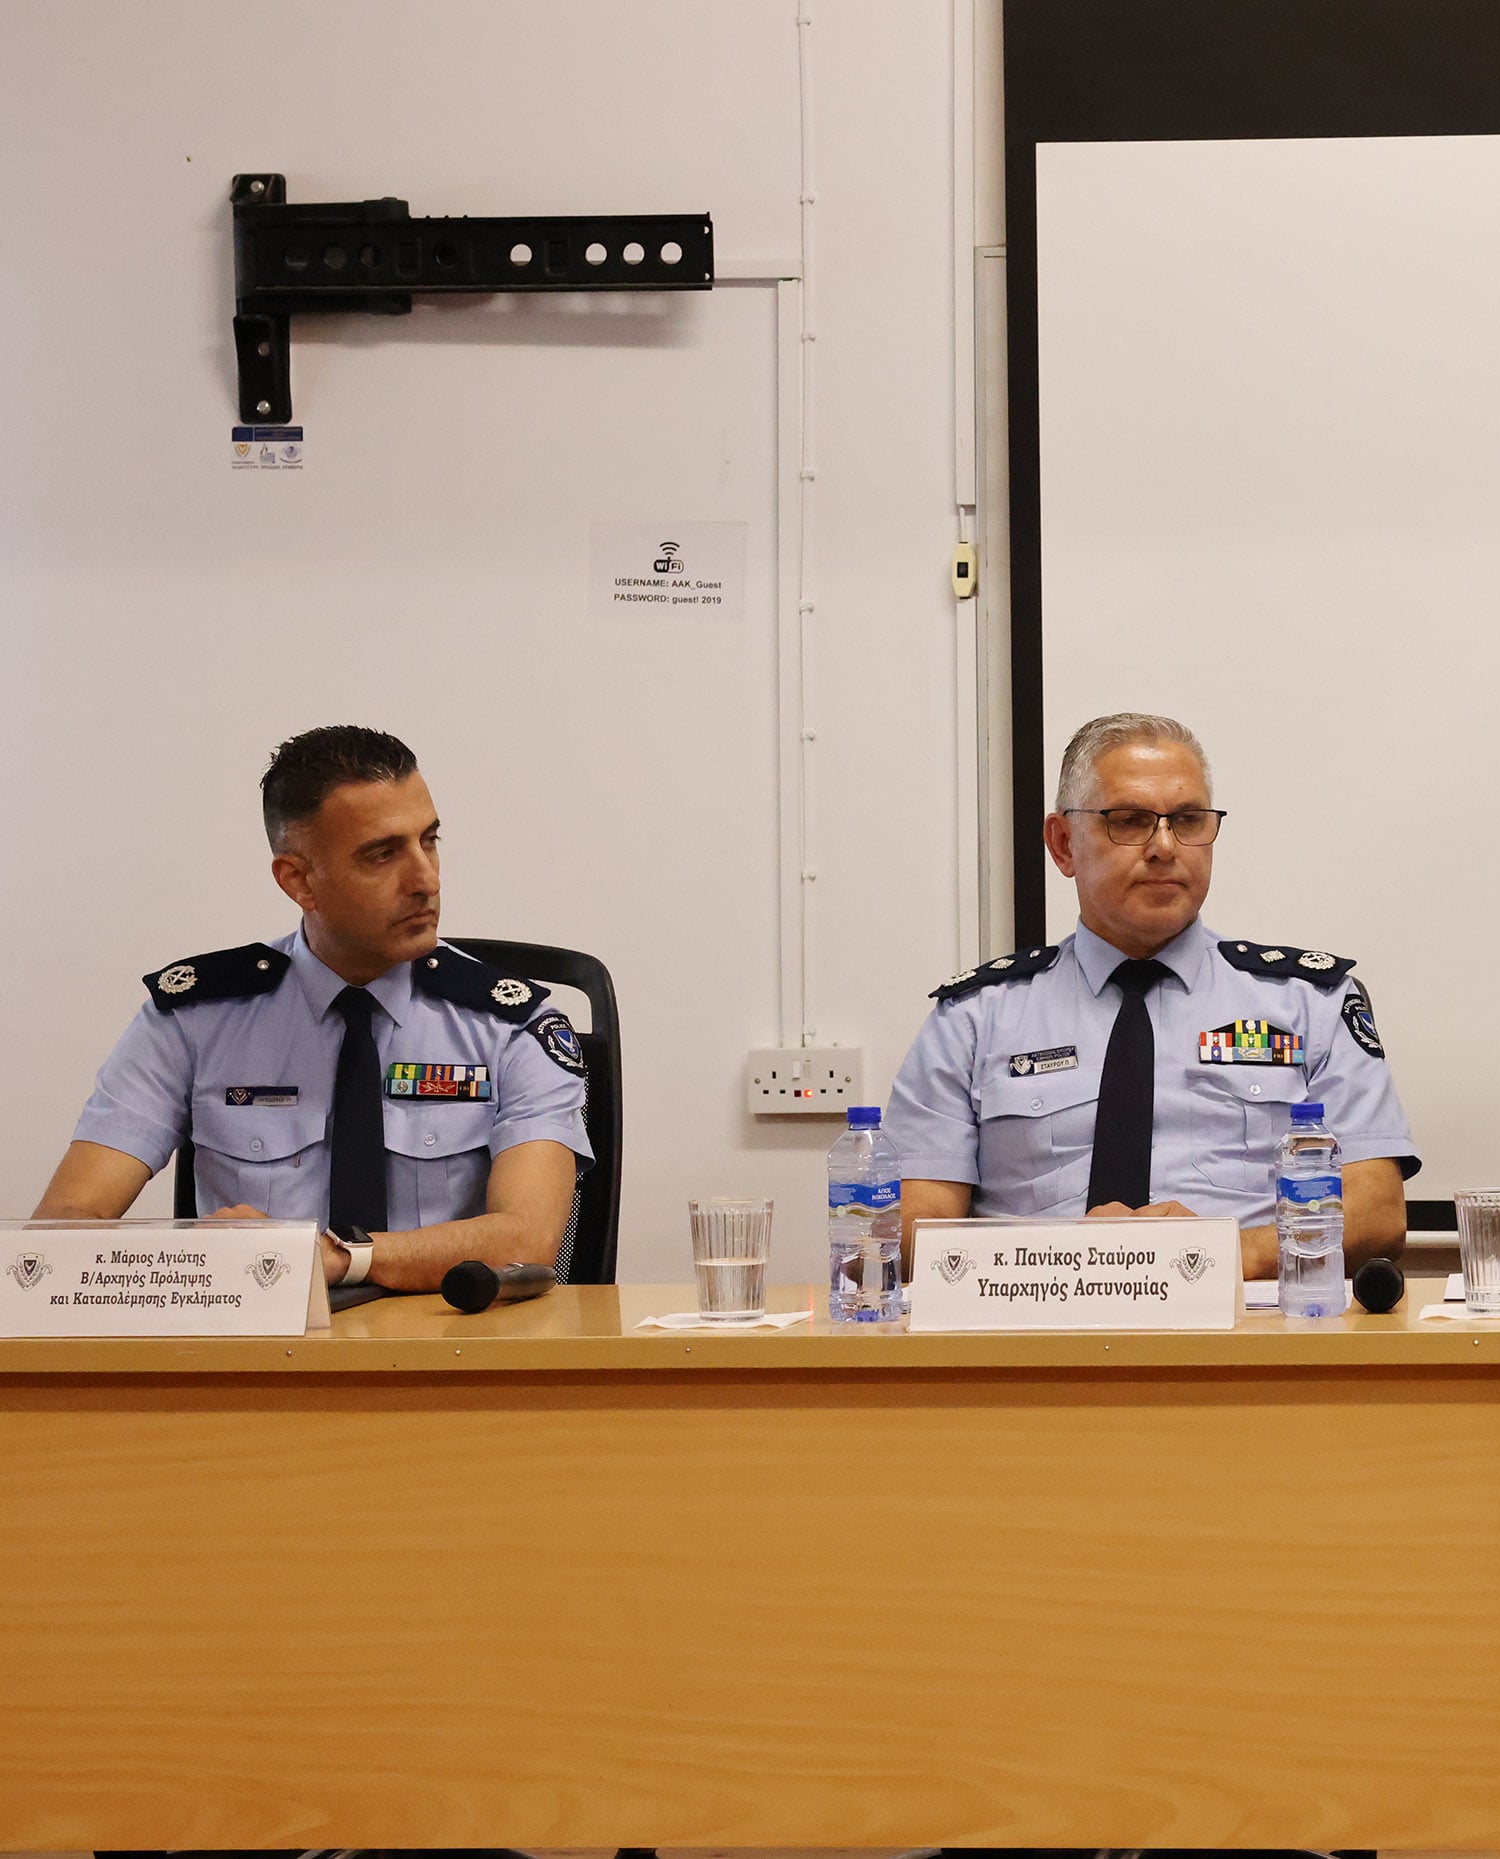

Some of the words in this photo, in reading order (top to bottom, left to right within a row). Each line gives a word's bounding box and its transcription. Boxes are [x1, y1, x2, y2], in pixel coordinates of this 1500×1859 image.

[615, 578, 669, 587] USERNAME:
[671, 580, 722, 590] AAK_Guest
[614, 593, 669, 603] PASSWORD:
[701, 596, 722, 604] 2019
[1040, 1060, 1064, 1070] ΣΤΑΥΡΟΥ
[95, 1253, 107, 1264] κ.
[111, 1250, 154, 1267] Μάριος
[157, 1250, 206, 1267] Αγιώτης
[995, 1253, 1008, 1266] κ.
[1014, 1246, 1082, 1271] Πανίκος
[1087, 1245, 1156, 1269] Σταύρου
[80, 1271, 146, 1288] Β/Αρχηγός
[150, 1271, 213, 1288] Πρόληψης
[977, 1277, 1068, 1302] Υπαρχηγός
[1073, 1275, 1169, 1301] Αστυνομίας
[50, 1295, 69, 1306] και
[73, 1290, 167, 1308] Καταπολέμησης
[171, 1290, 242, 1308] Εγκλήματος
